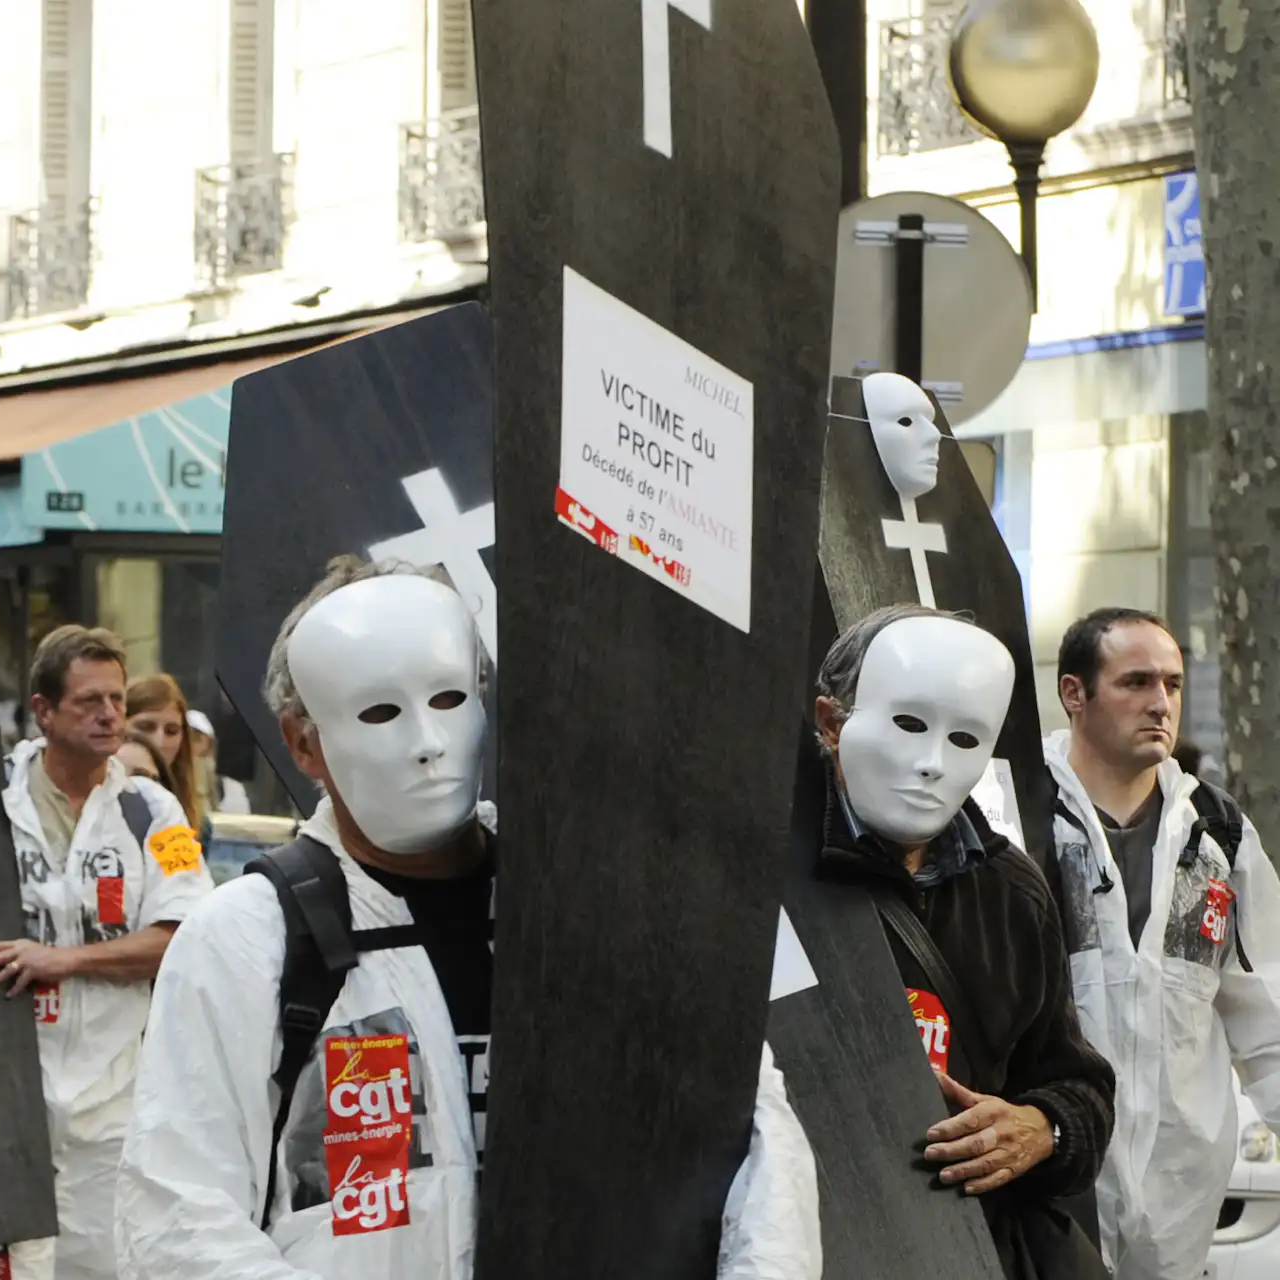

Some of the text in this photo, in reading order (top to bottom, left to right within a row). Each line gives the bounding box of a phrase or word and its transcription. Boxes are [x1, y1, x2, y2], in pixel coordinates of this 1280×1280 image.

[600, 368, 717, 462] VICTIME du
[168, 447, 204, 489] le
[581, 443, 634, 489] Décédé
[637, 478, 655, 500] de
[618, 421, 694, 488] PROFIT
[626, 503, 684, 552] à 57 ans
[987, 808, 1000, 821] du
[33, 989, 59, 1019] gt
[915, 1015, 948, 1055] gt
[329, 1068, 411, 1125] cgt
[323, 1122, 402, 1145] mines-énergie
[334, 1154, 400, 1192] la
[332, 1167, 405, 1228] cgt
